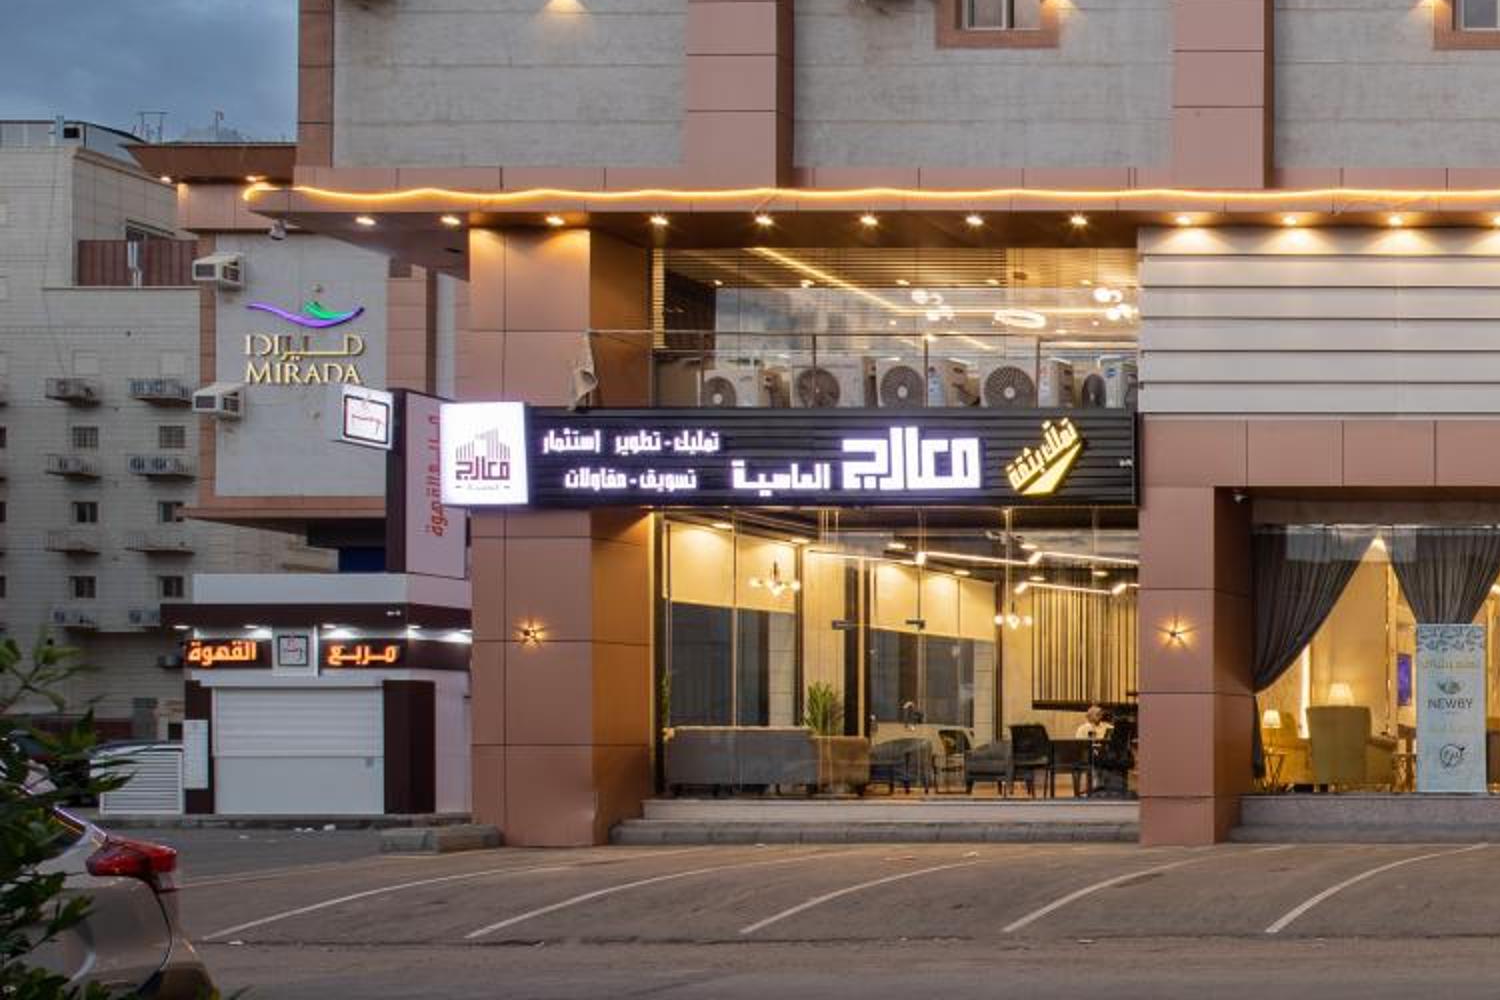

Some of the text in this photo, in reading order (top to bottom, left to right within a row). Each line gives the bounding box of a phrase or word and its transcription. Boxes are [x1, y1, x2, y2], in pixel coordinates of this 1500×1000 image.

[245, 361, 363, 384] MIRADA
[542, 427, 601, 455] استثمار
[614, 429, 661, 456] تطوير
[674, 429, 720, 455] تمليك
[564, 467, 627, 491] مقاولات
[639, 469, 697, 492] تسويق
[188, 640, 258, 667] القهوة
[327, 643, 400, 666] مربع
